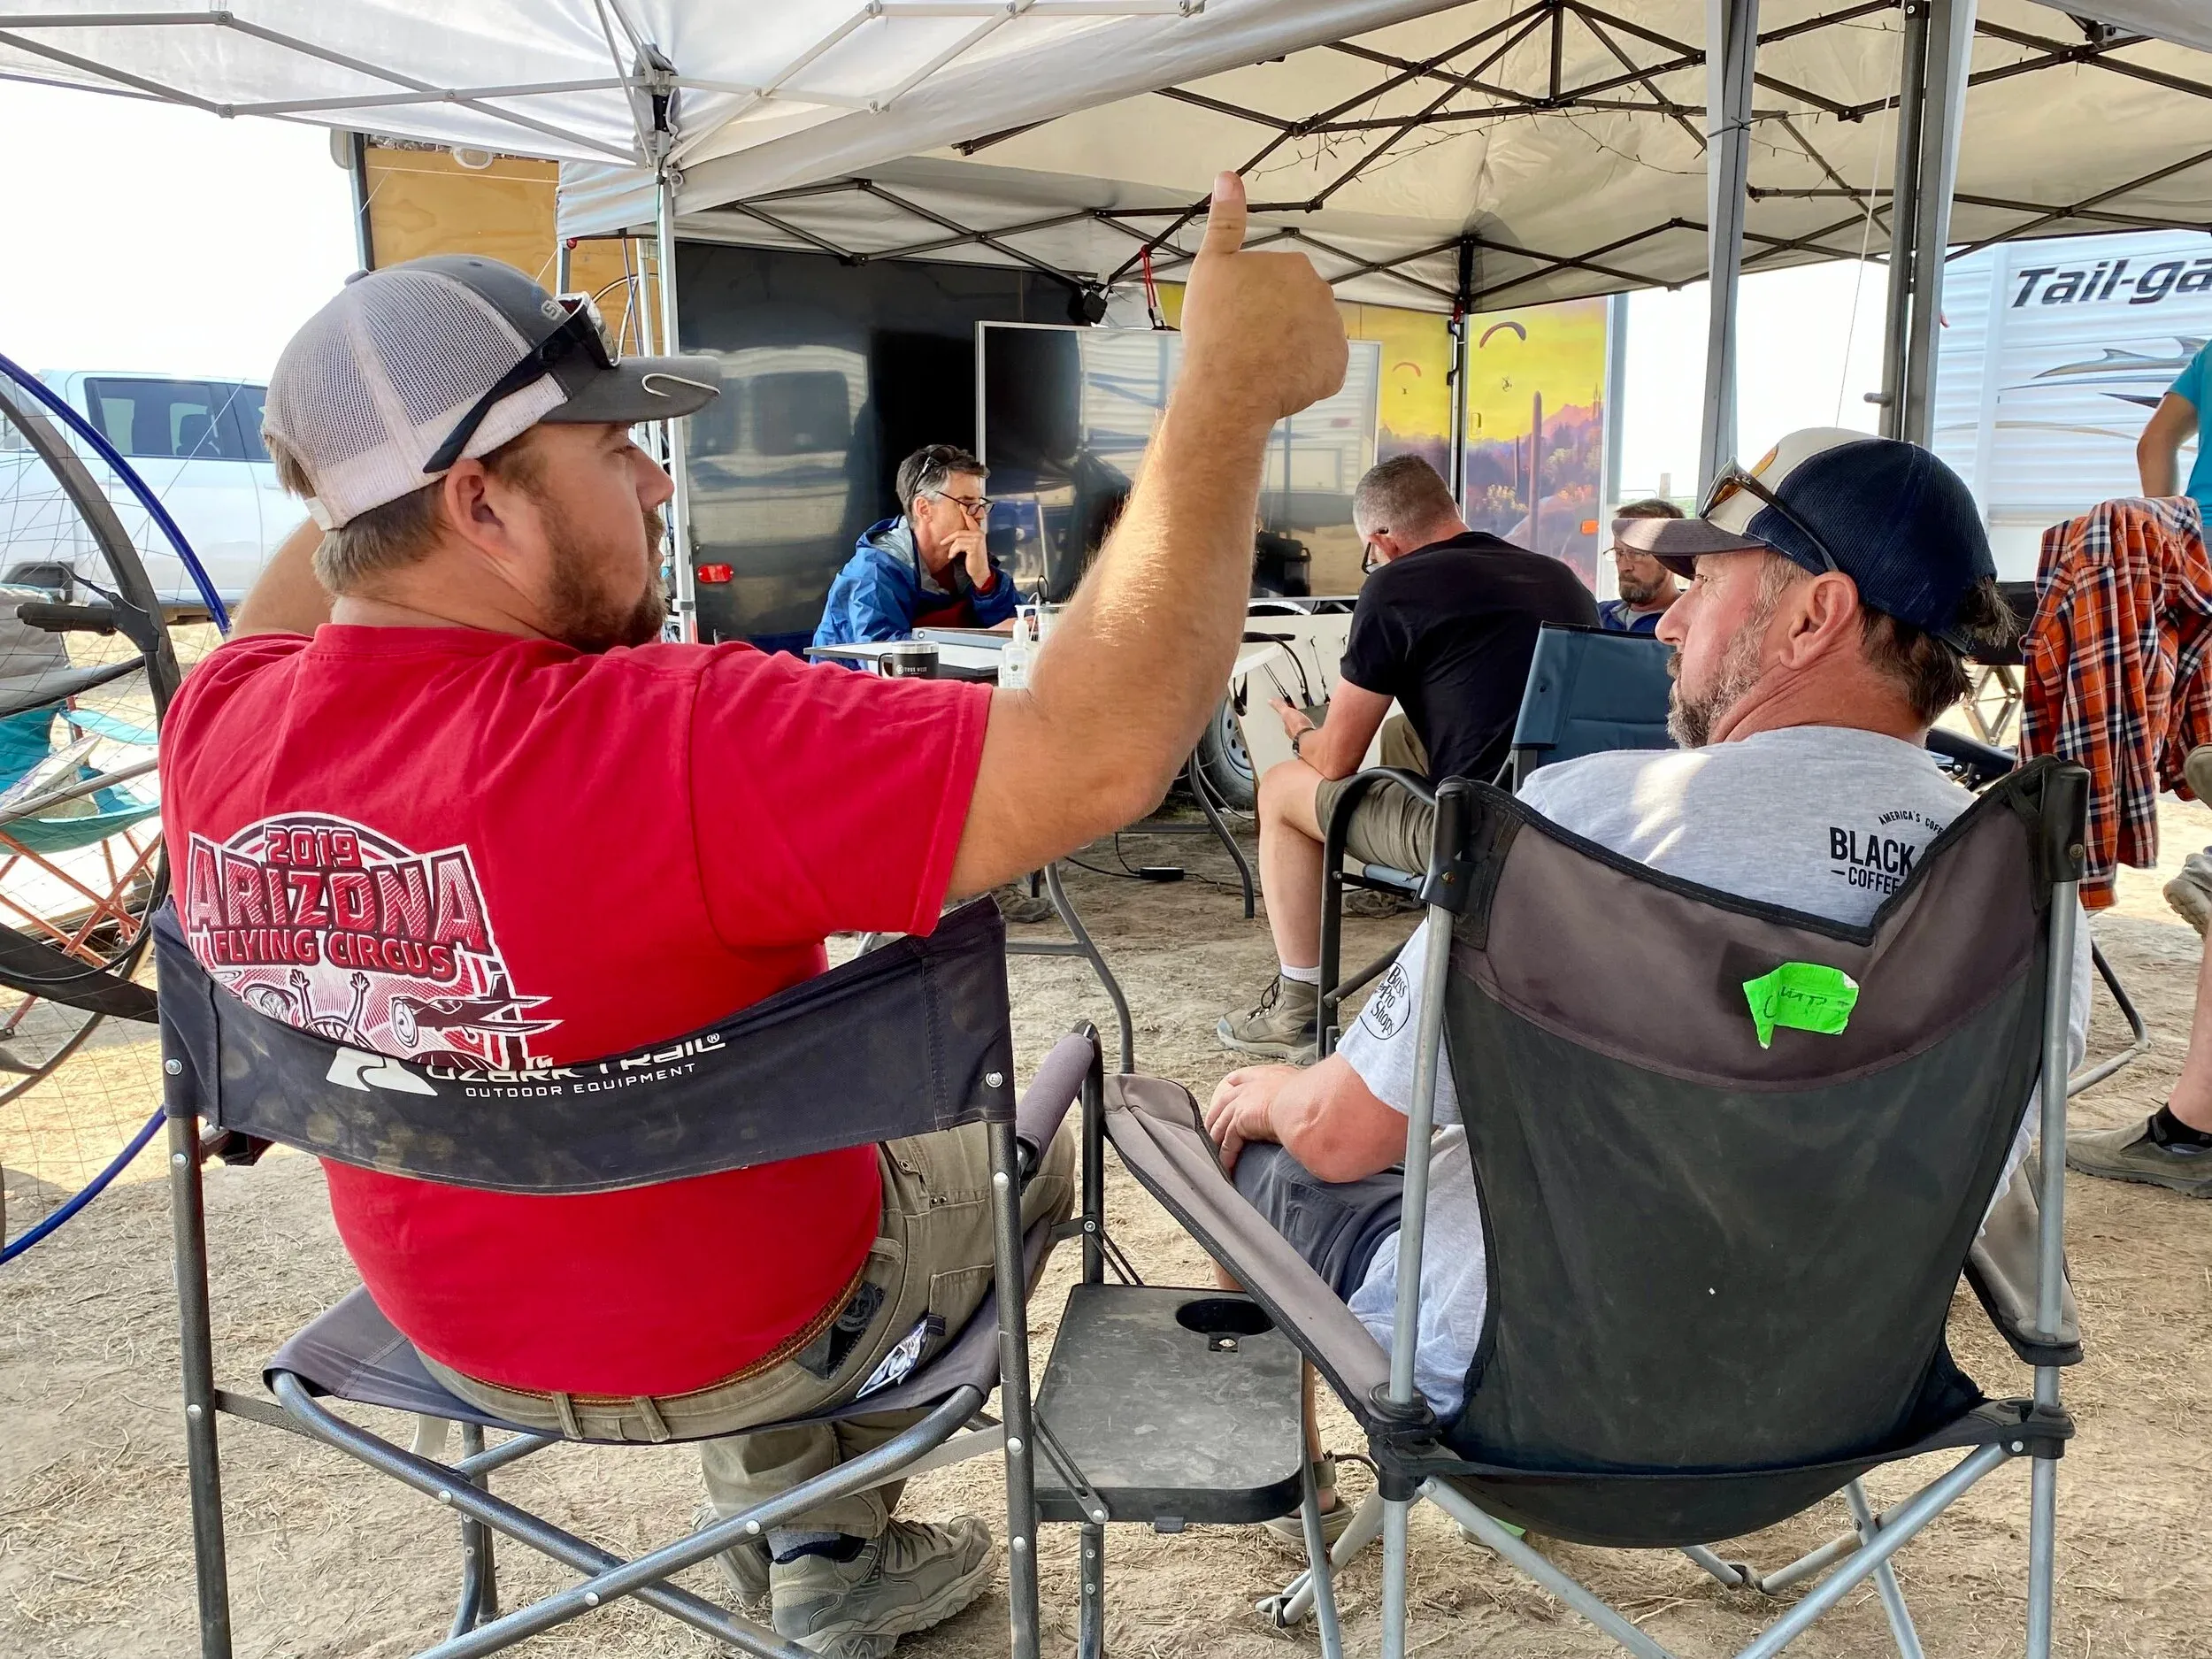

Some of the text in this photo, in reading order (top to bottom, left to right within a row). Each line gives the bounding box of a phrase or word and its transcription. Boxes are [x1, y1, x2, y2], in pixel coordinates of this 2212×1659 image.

[1878, 810, 1921, 826] AMERICA'S
[265, 827, 360, 868] 2019
[1829, 826, 1916, 876] BLACK
[188, 836, 491, 951] ARIZONA
[212, 928, 457, 980] FLYING CIRCUS
[1379, 984, 1395, 1008] Pro
[1386, 965, 1408, 998] Bass
[1371, 1001, 1394, 1036] Shops
[465, 1063, 695, 1098] OUTDOOR EQUIPMENT
